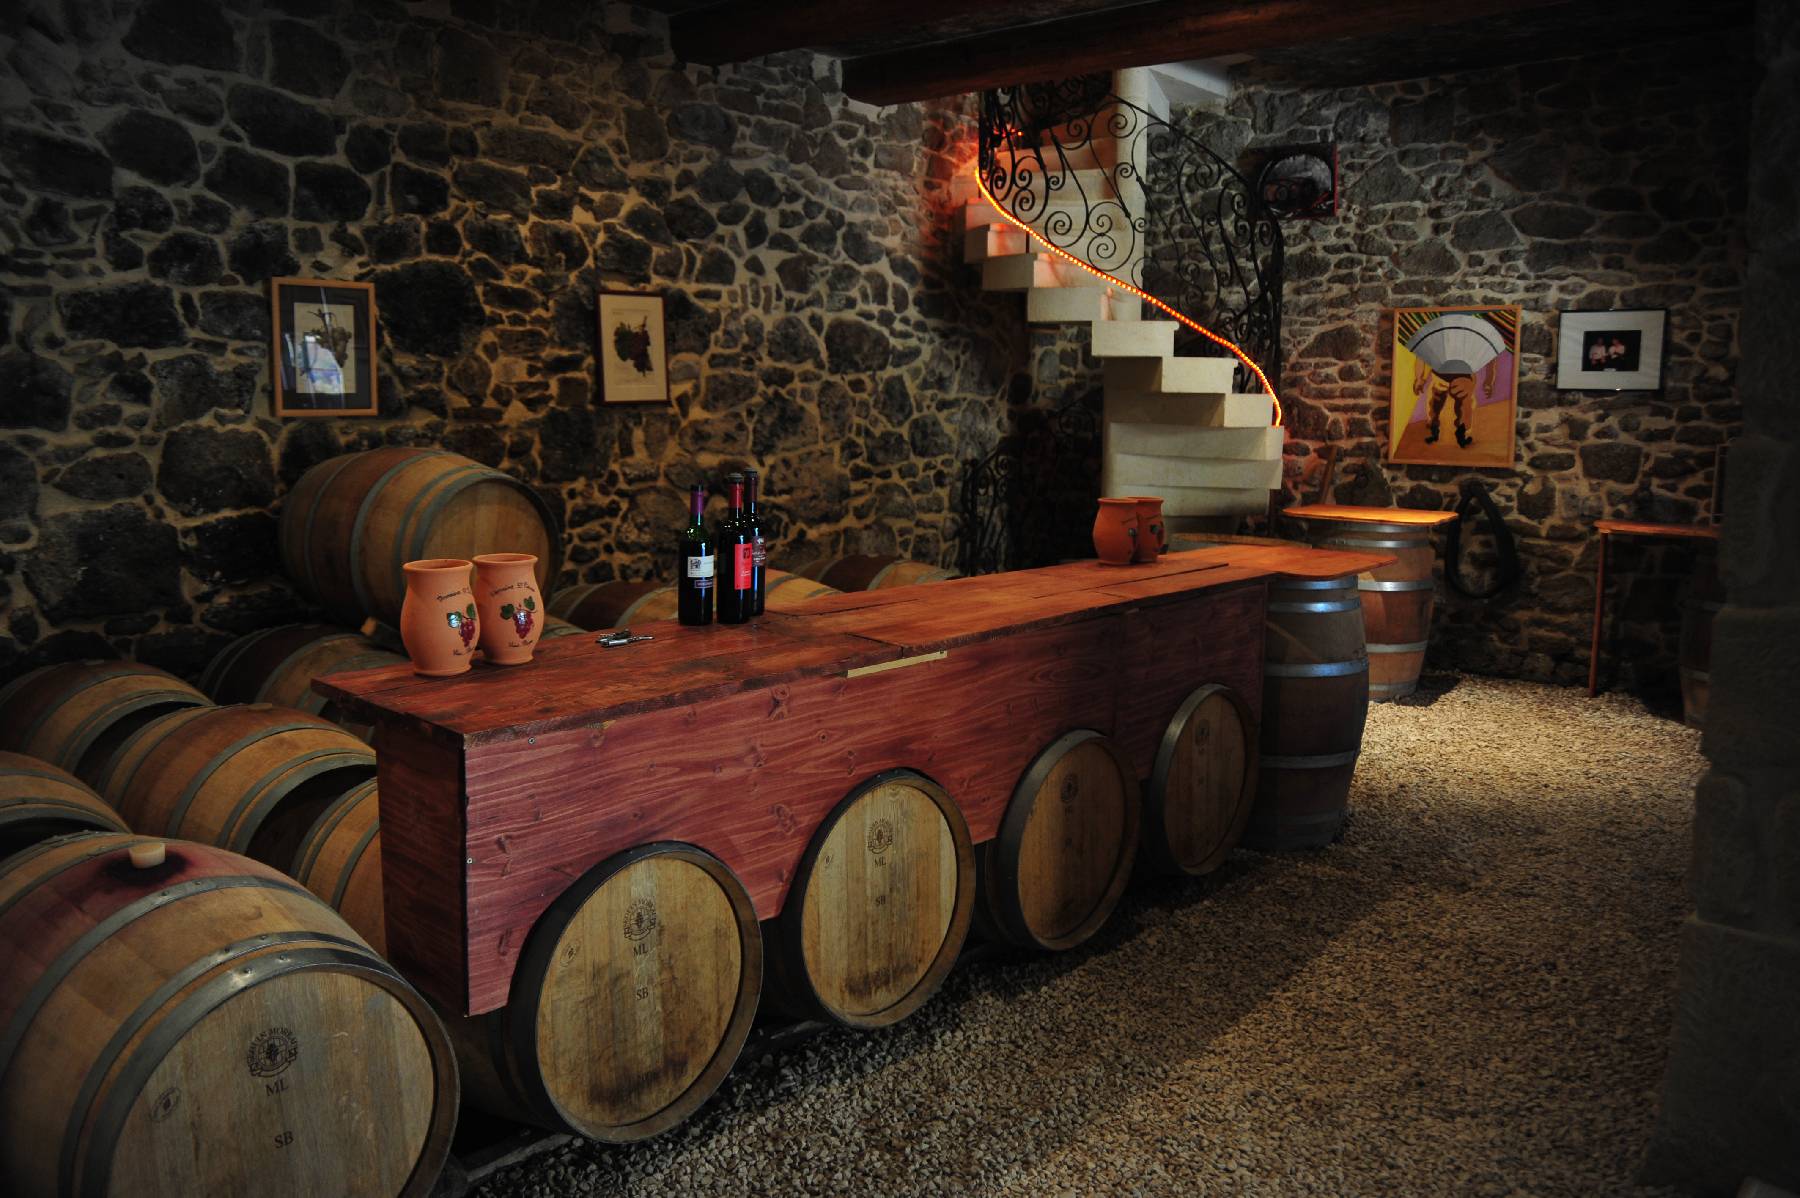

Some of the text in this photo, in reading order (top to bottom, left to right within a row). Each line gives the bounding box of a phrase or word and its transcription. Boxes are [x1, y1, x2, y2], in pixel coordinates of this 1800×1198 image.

[633, 943, 649, 956] ML
[636, 987, 649, 1001] SB
[266, 1079, 288, 1096] ML
[275, 1131, 293, 1148] SB
